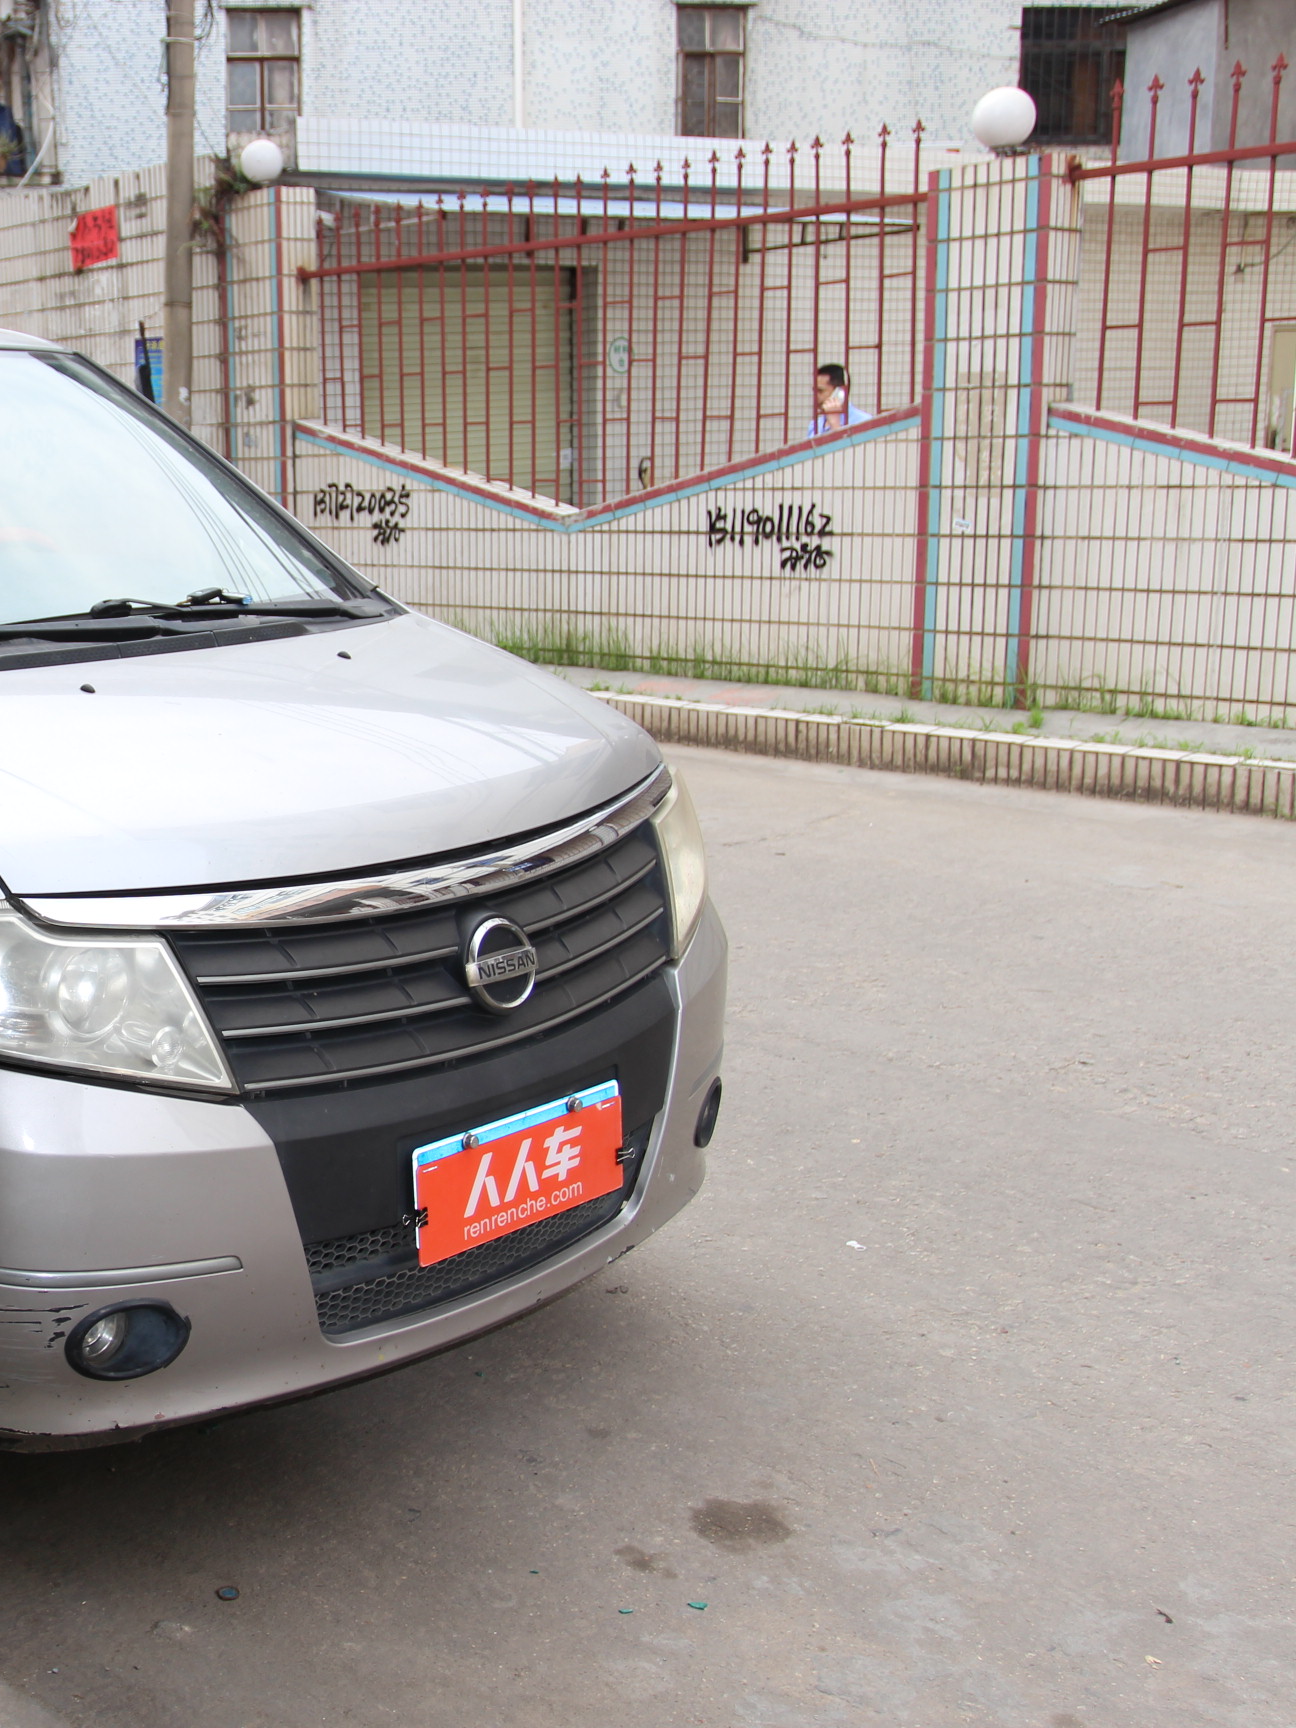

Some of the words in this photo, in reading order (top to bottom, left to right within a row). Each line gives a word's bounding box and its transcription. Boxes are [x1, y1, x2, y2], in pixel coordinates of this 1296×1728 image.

[478, 952, 536, 980] NISSAN
[463, 1125, 583, 1219] 人人车
[463, 1181, 583, 1241] renrenche.com
